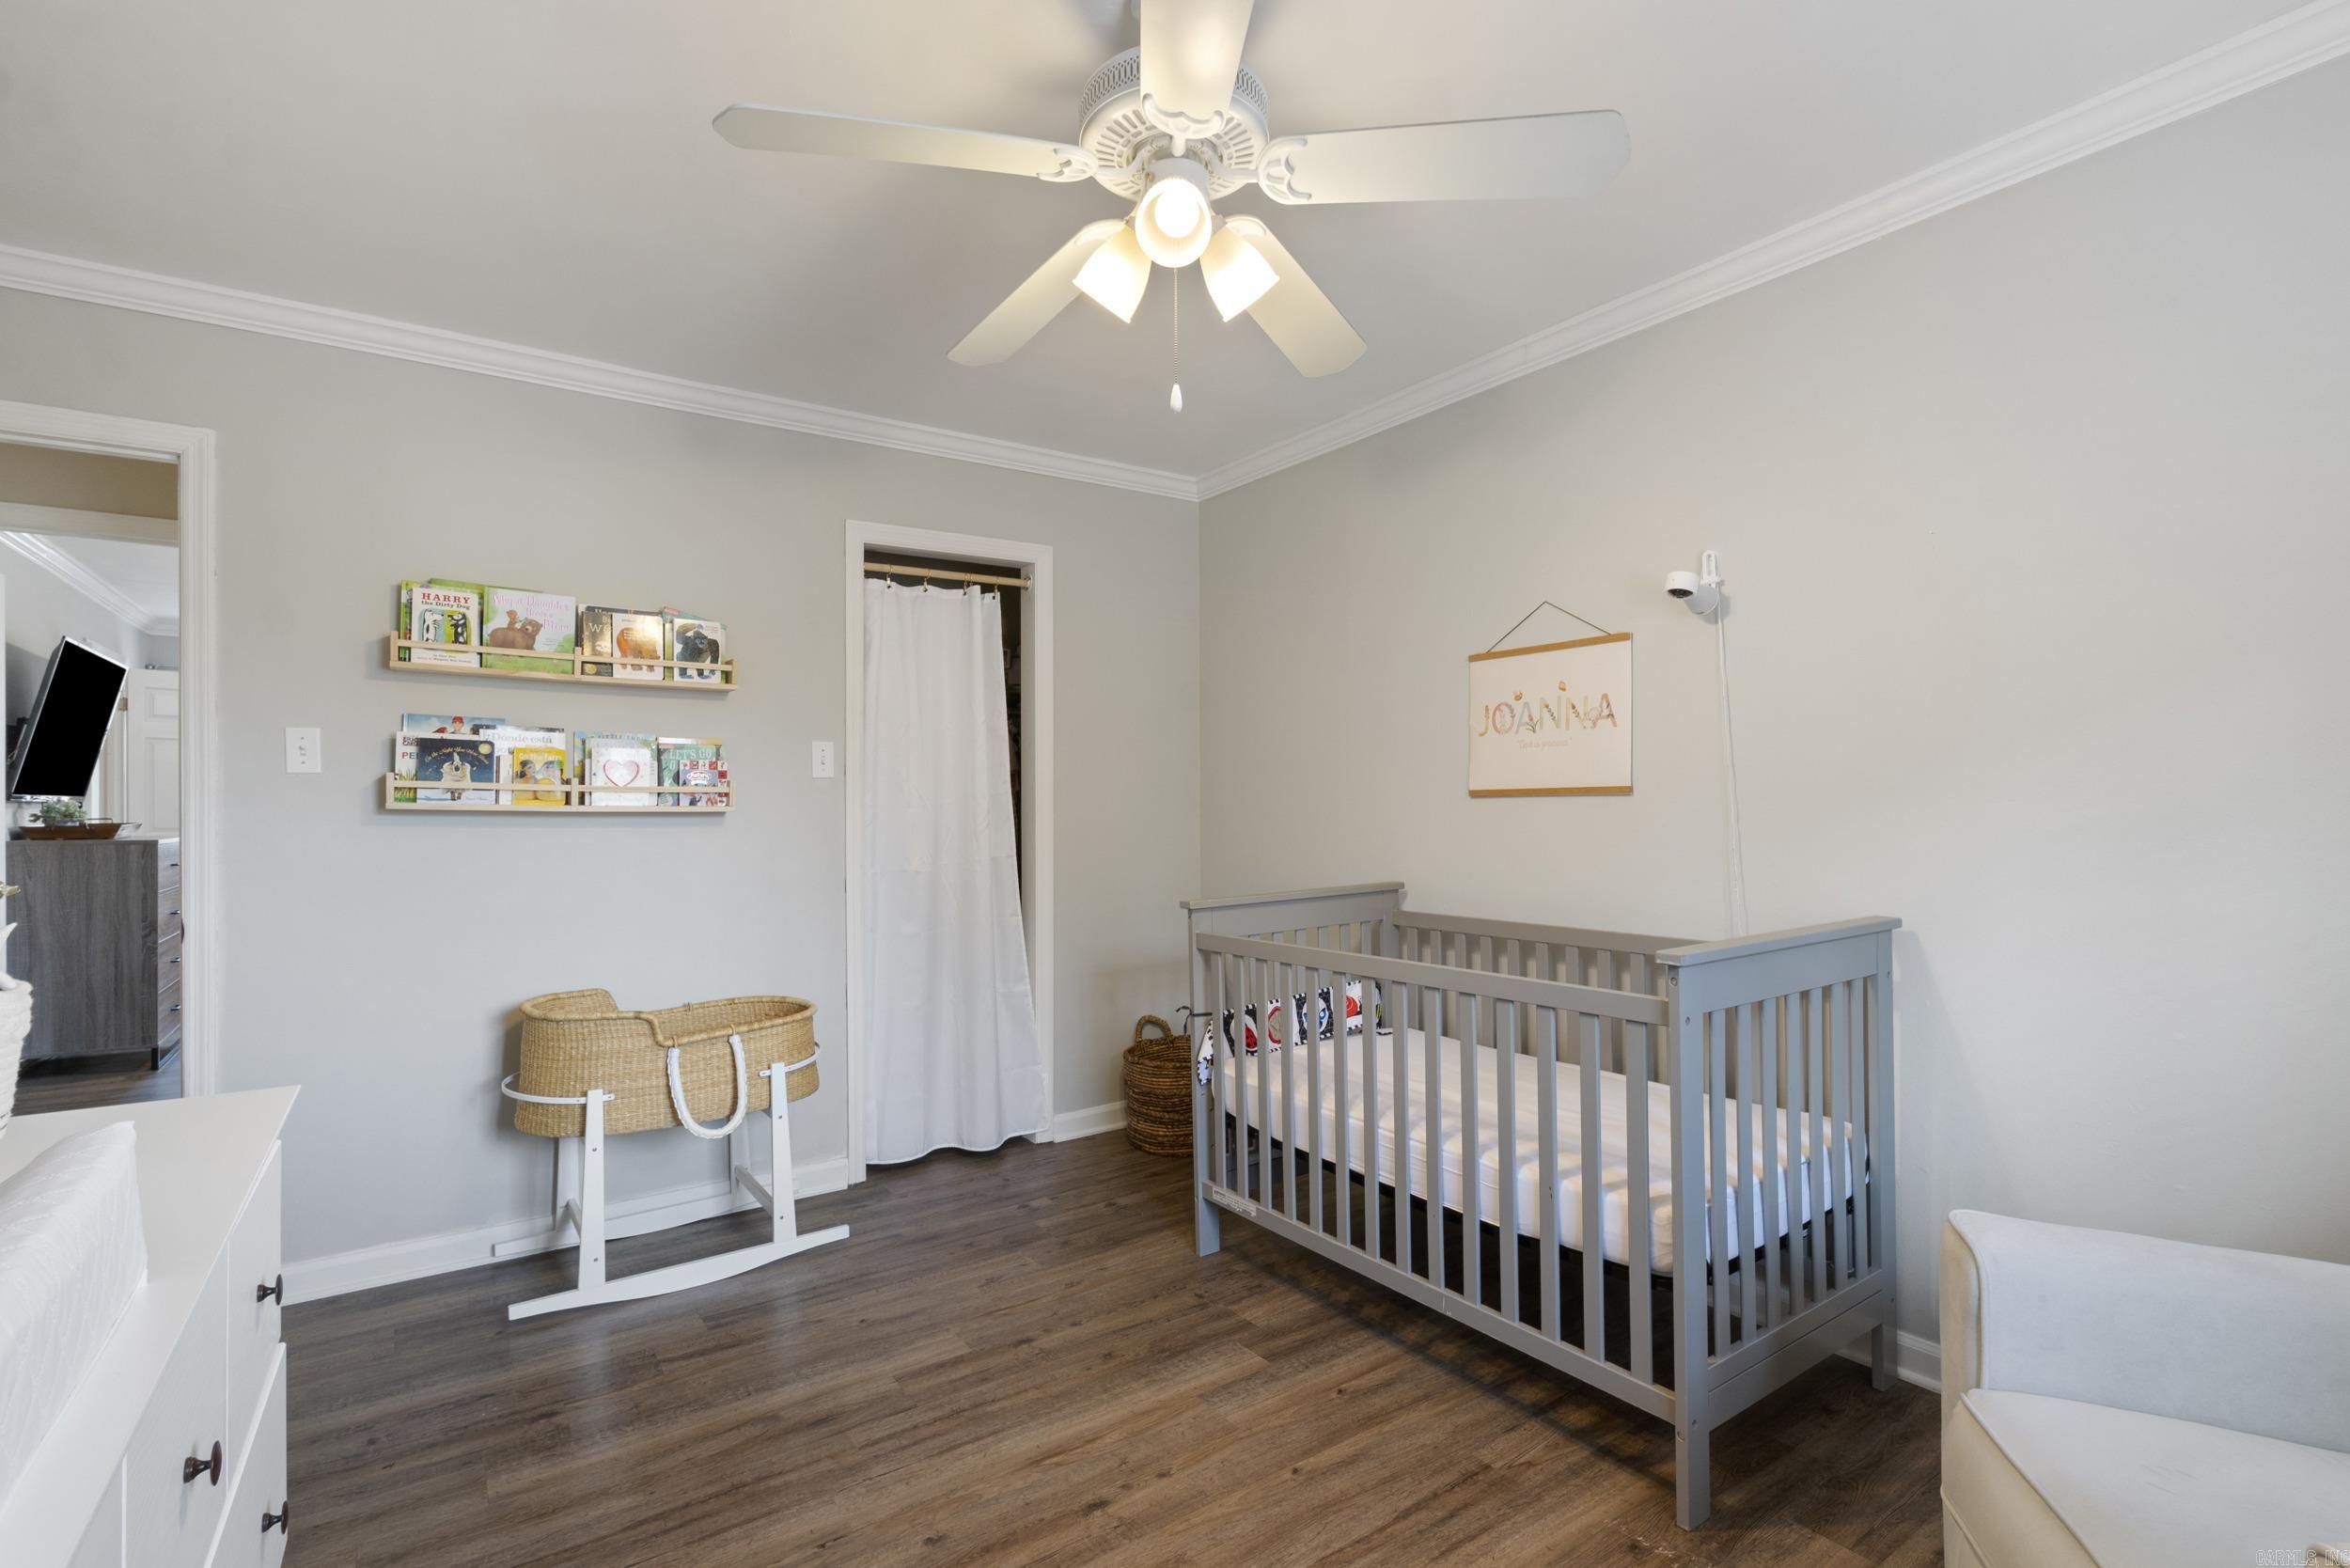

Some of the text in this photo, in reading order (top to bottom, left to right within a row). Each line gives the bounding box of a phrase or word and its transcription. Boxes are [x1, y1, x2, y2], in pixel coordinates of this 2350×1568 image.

[421, 592, 471, 604] HARRY
[1479, 693, 1617, 737] JOANNA
[669, 748, 713, 760] LET'S GO
